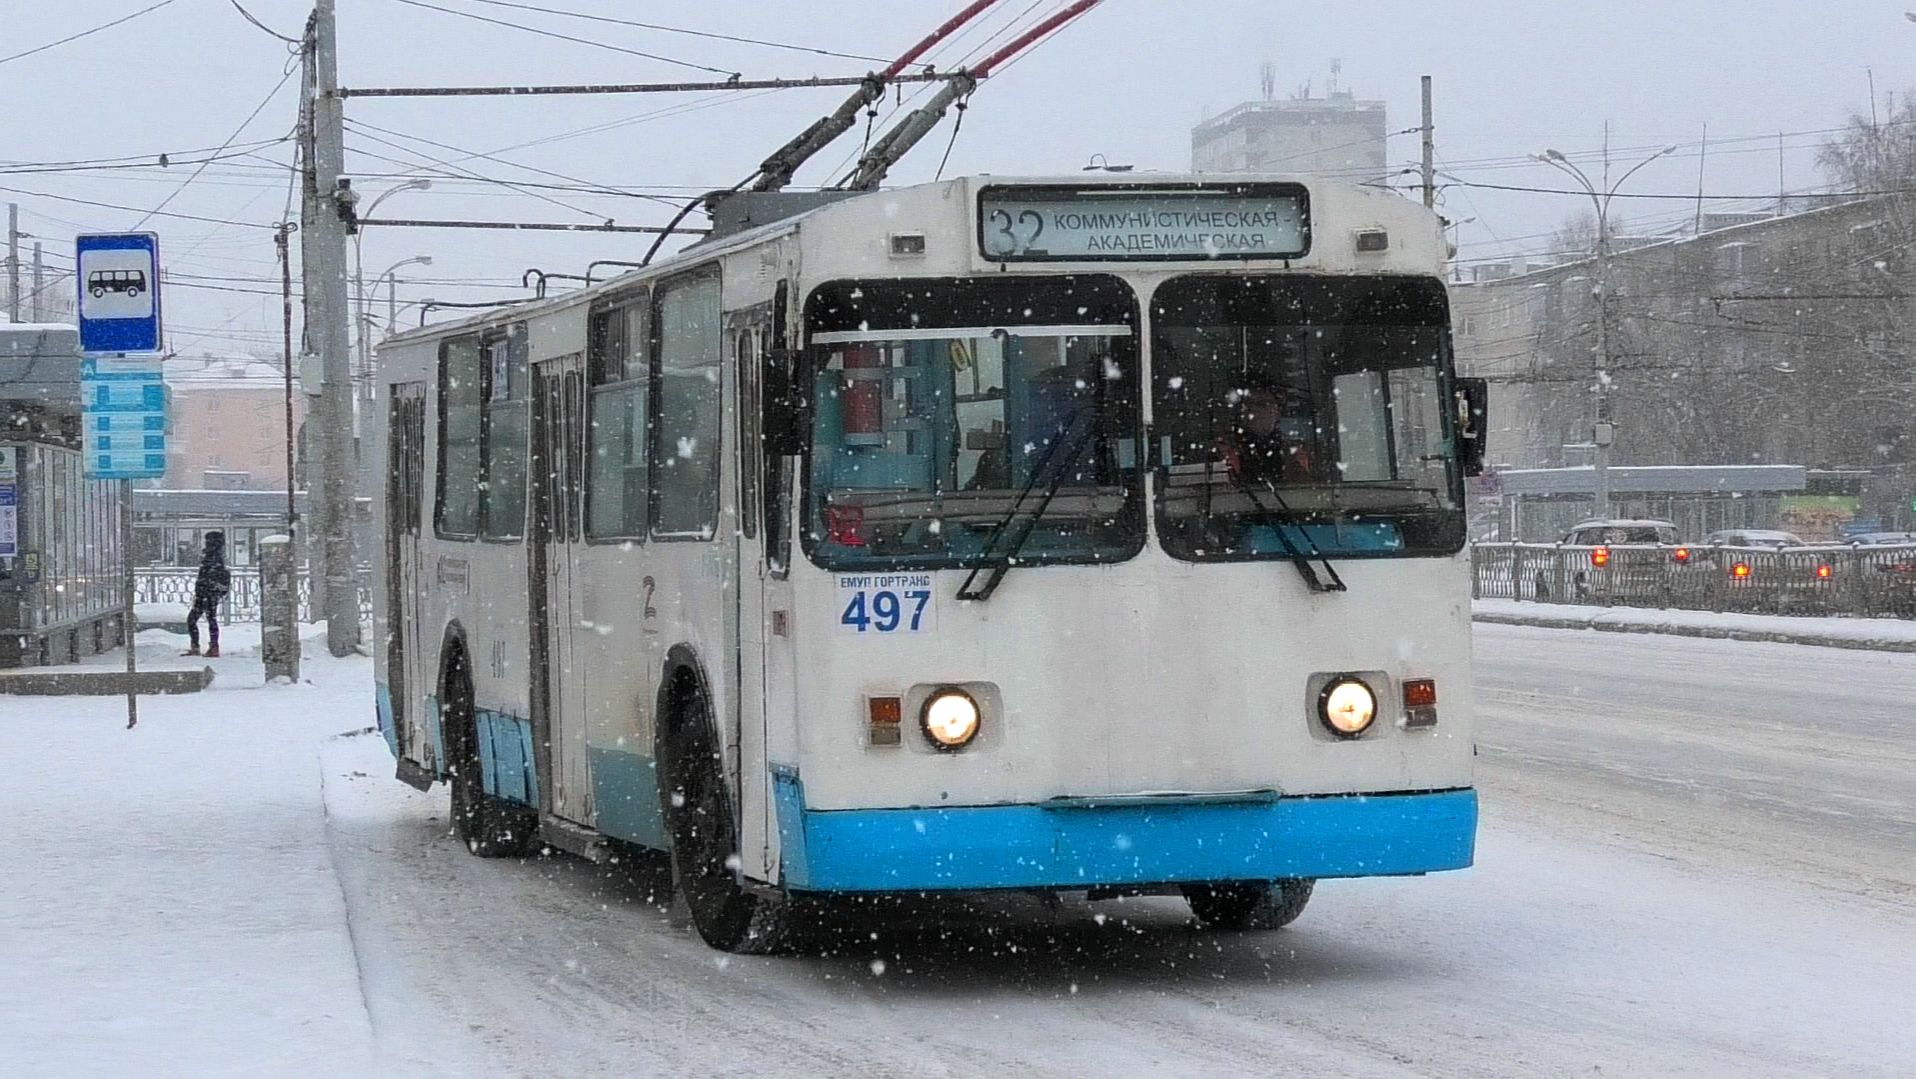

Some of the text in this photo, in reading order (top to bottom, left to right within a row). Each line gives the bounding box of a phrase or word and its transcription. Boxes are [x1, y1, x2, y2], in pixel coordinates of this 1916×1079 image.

[1054, 211, 1278, 230] КОММУНИСТИЧЕСКАЯ
[989, 208, 1049, 256] 32
[1087, 233, 1266, 252] АКАДЕМИЧЕСКАЯ
[840, 575, 931, 588] ЕМУП ГОРТРАНС
[841, 590, 931, 632] 497
